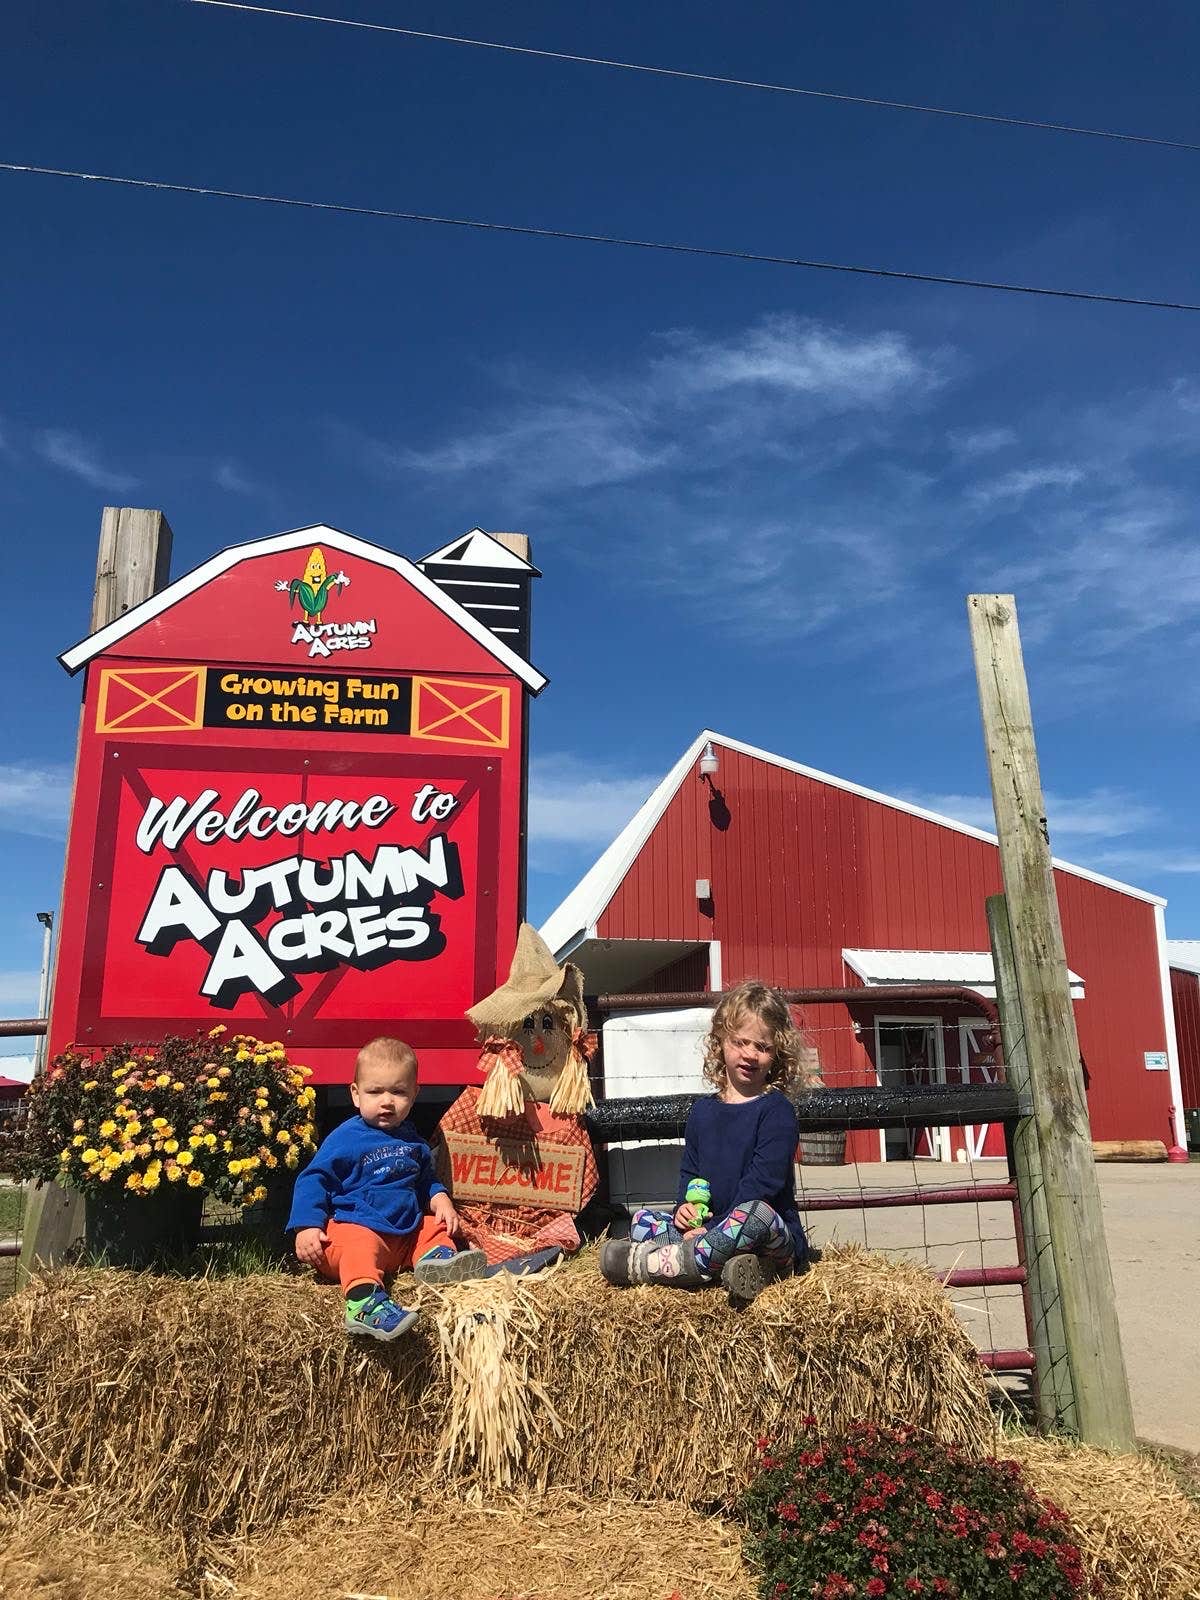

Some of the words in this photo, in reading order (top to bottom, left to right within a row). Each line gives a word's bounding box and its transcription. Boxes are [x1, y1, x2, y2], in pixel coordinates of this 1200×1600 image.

[291, 619, 377, 643] AUTUMN
[308, 636, 371, 657] ACRES
[220, 673, 339, 702] Growing
[347, 678, 400, 700] Fun
[226, 703, 263, 721] on
[271, 702, 317, 723] the
[324, 703, 389, 726] Farm
[136, 788, 394, 853] Welcome
[411, 784, 457, 822] to
[137, 837, 453, 945] AUTUMN
[202, 905, 431, 998] ACRES
[452, 1152, 573, 1194] WELCOME
